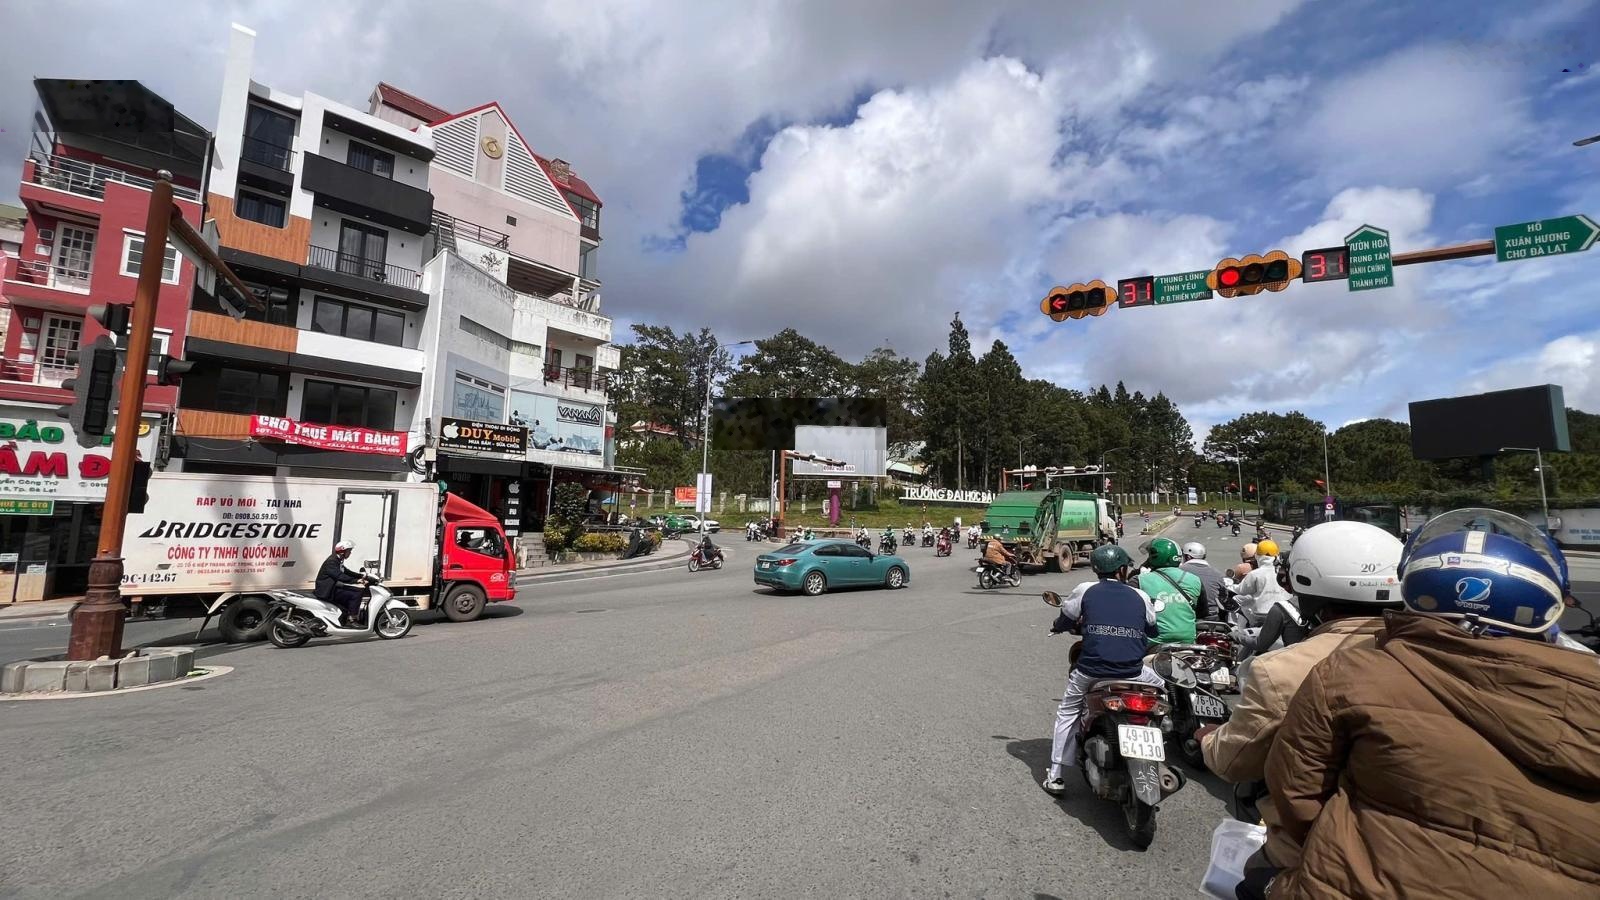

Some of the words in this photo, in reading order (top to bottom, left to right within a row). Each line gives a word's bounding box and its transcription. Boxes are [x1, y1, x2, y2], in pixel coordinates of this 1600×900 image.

[1505, 236, 1532, 248] XUÂN
[1534, 231, 1571, 244] HƯƠNG
[1505, 248, 1527, 260] CHỢ
[1530, 244, 1545, 256] ĐÀ
[1547, 243, 1569, 255] LẠT
[1310, 253, 1344, 278] 31
[1123, 282, 1151, 304] 31
[1181, 282, 1197, 291] YÊU
[0, 419, 65, 443] BẢO
[258, 415, 290, 431] CHO
[460, 426, 494, 440] DUY
[492, 434, 521, 444] Mobile
[138, 520, 322, 539] BRIDGESTONE
[167, 543, 195, 560] CÔNG
[198, 546, 211, 559] TY
[213, 546, 239, 560] TNHH
[242, 542, 268, 559] QUỐC
[268, 546, 289, 559] NAM
[1455, 600, 1491, 611] VNPT
[1122, 741, 1162, 759] 541.30
